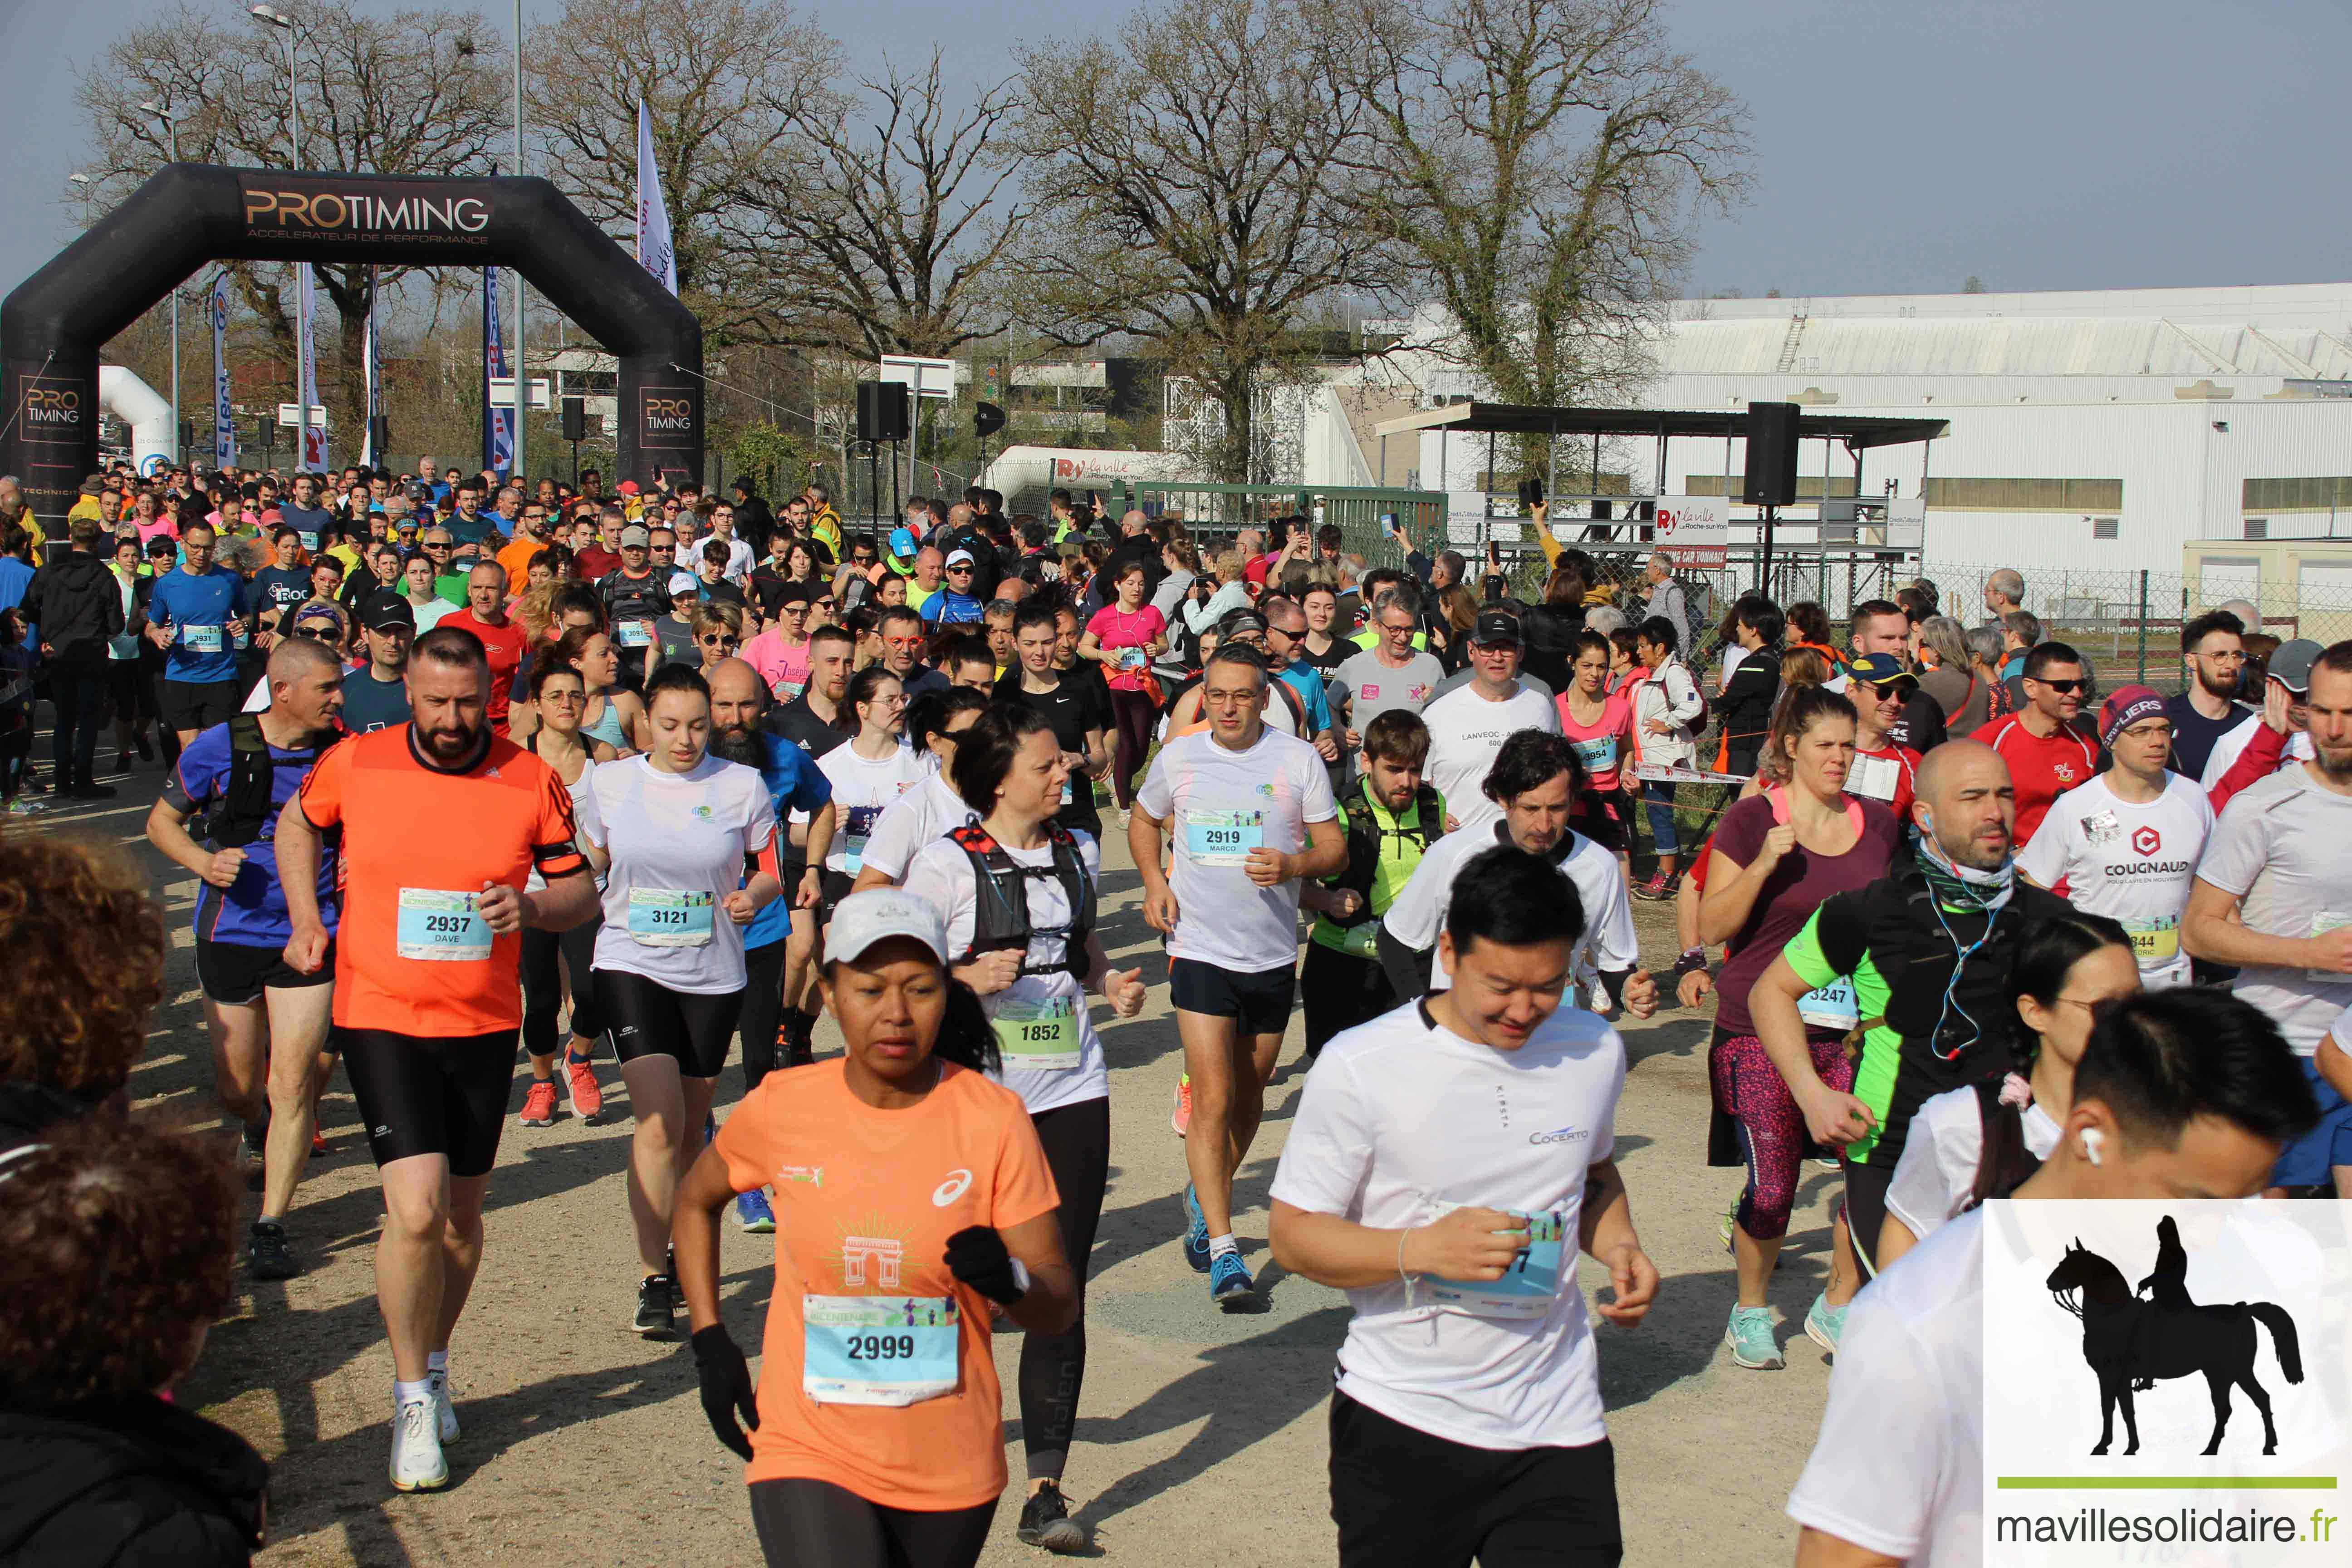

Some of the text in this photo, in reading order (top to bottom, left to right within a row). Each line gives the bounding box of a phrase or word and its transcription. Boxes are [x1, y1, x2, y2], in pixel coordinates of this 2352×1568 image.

[246, 190, 489, 232] PROTIMING
[247, 229, 489, 245] ACCELERATEUR DE PERFORMANCE
[27, 389, 79, 410] PRO
[646, 399, 690, 416] PRO
[28, 407, 79, 423] TIMING
[646, 416, 690, 429] TIMING
[1462, 731, 1499, 740] LANVEOC
[1206, 830, 1240, 843] 2919
[2104, 861, 2189, 876] COUGNAUD
[426, 916, 471, 932] 2937
[652, 910, 687, 923] 3121
[435, 935, 461, 943] DAVE
[1810, 988, 1846, 1003] 3247
[1021, 1024, 1060, 1040] 1852
[1496, 1085, 1509, 1128] KIPSTA
[848, 1335, 914, 1360] 2999
